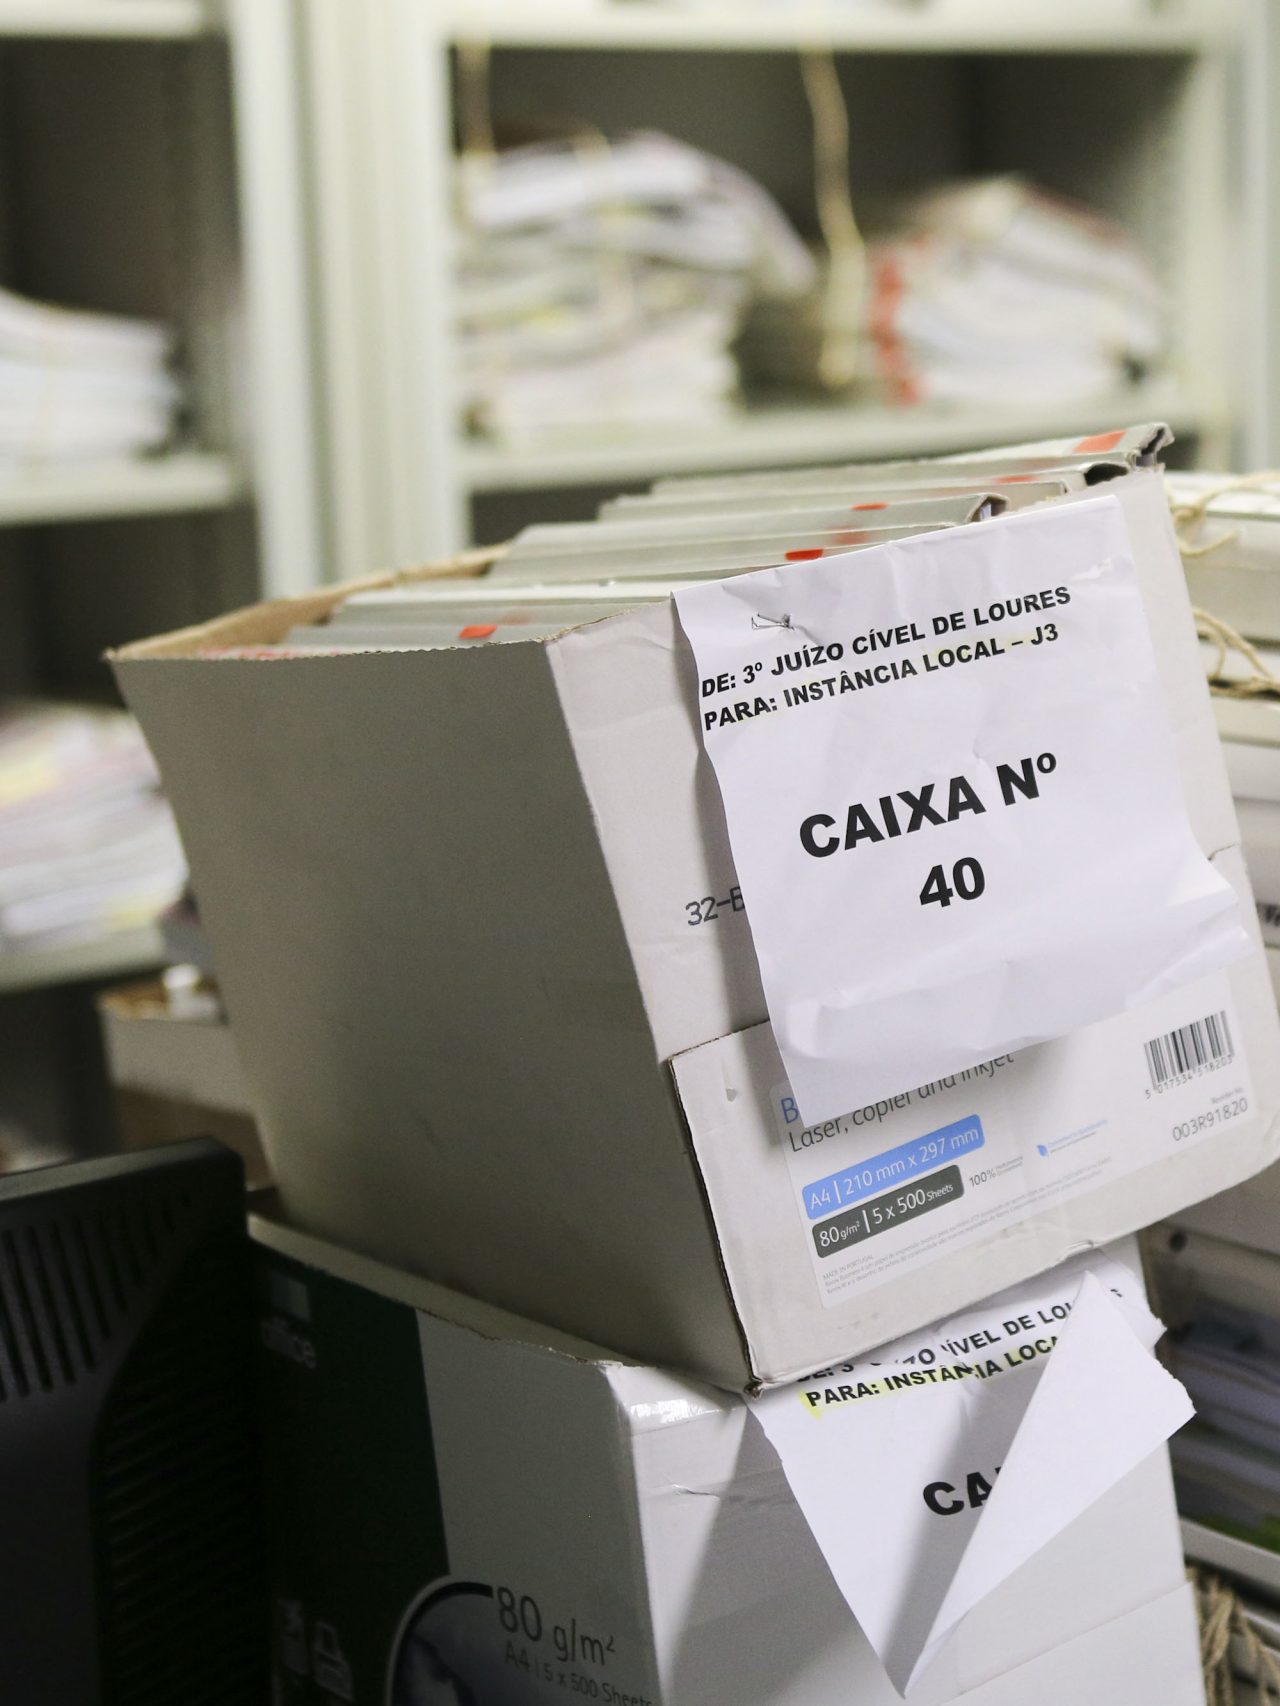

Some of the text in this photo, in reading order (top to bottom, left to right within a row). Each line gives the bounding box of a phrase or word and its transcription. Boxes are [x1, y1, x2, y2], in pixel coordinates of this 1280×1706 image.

[702, 586, 1072, 698] DE: 3º JUÍZO CÍVEL DE LOURES
[704, 696, 778, 731] PARA:
[783, 658, 918, 708] INSTÂNCIA
[922, 638, 1006, 673] LOCAL
[1030, 623, 1059, 646] J3
[799, 752, 1057, 858] CAIXA Nº
[919, 856, 986, 908] 40
[789, 1114, 848, 1152] Laser,
[852, 1091, 912, 1126] copier
[1172, 1097, 1248, 1141] 003R91820
[811, 1127, 979, 1210] A4 210 mm x 297 mm
[969, 1168, 997, 1187] 100%
[872, 1207, 883, 1225] 5
[886, 1204, 896, 1219] x
[897, 1189, 926, 1214] 500
[940, 1329, 1002, 1357] ÍVEL
[1002, 1314, 1037, 1337] DE
[806, 1382, 880, 1407] PARA:
[884, 1359, 1003, 1391] INSTÂNIA
[1003, 1335, 1058, 1368] LOC
[498, 1586, 543, 1642] 80
[505, 1639, 530, 1669] A4
[571, 1672, 599, 1698] 500
